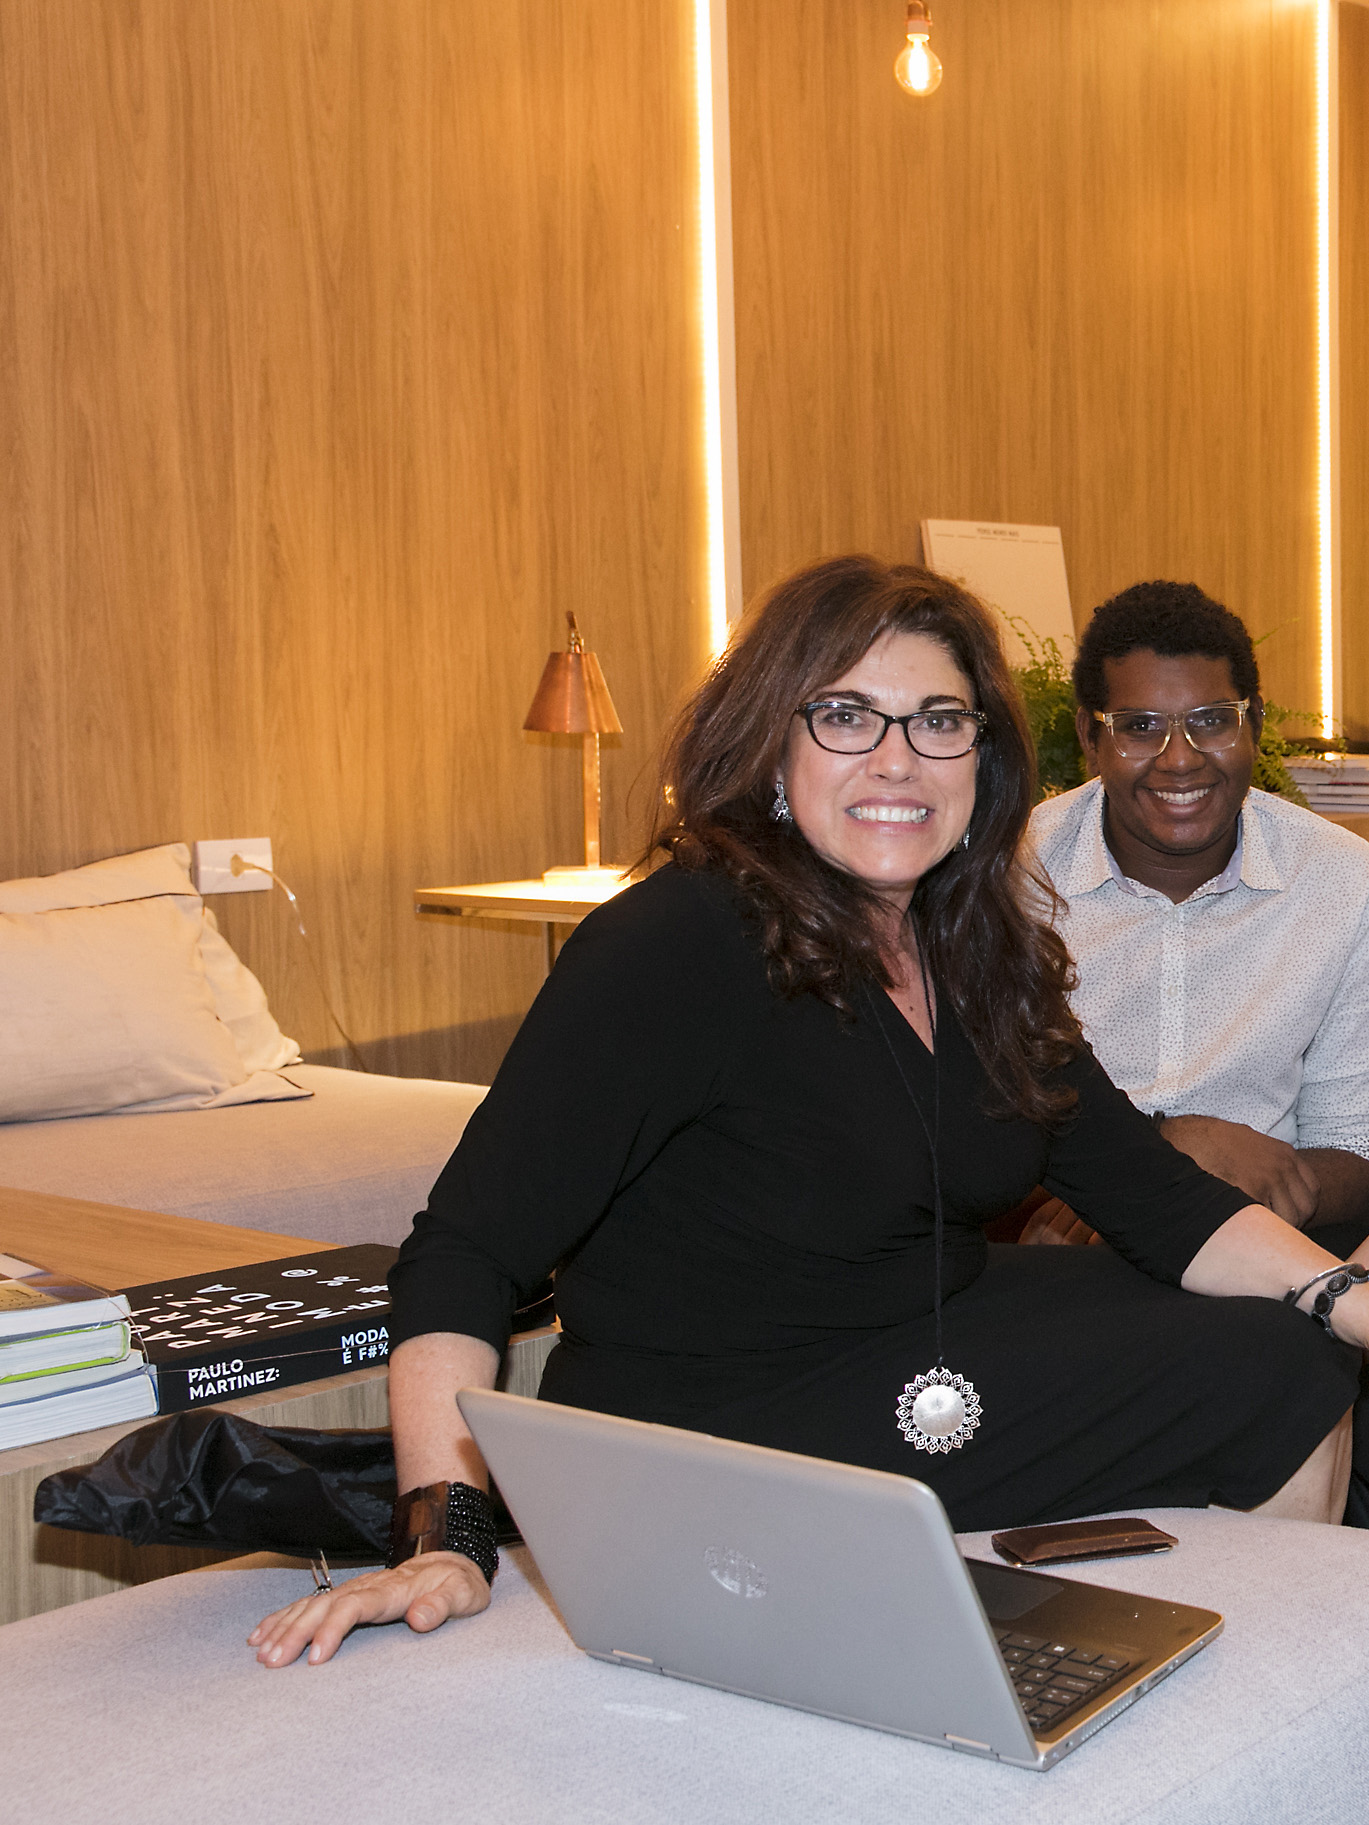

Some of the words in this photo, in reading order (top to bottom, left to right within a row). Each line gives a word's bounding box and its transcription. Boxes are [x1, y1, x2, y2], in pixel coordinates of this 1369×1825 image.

[341, 1326, 389, 1349] MODA
[342, 1347, 353, 1365] É
[188, 1358, 244, 1384] PAULO
[189, 1367, 280, 1401] MARTINEZ:
